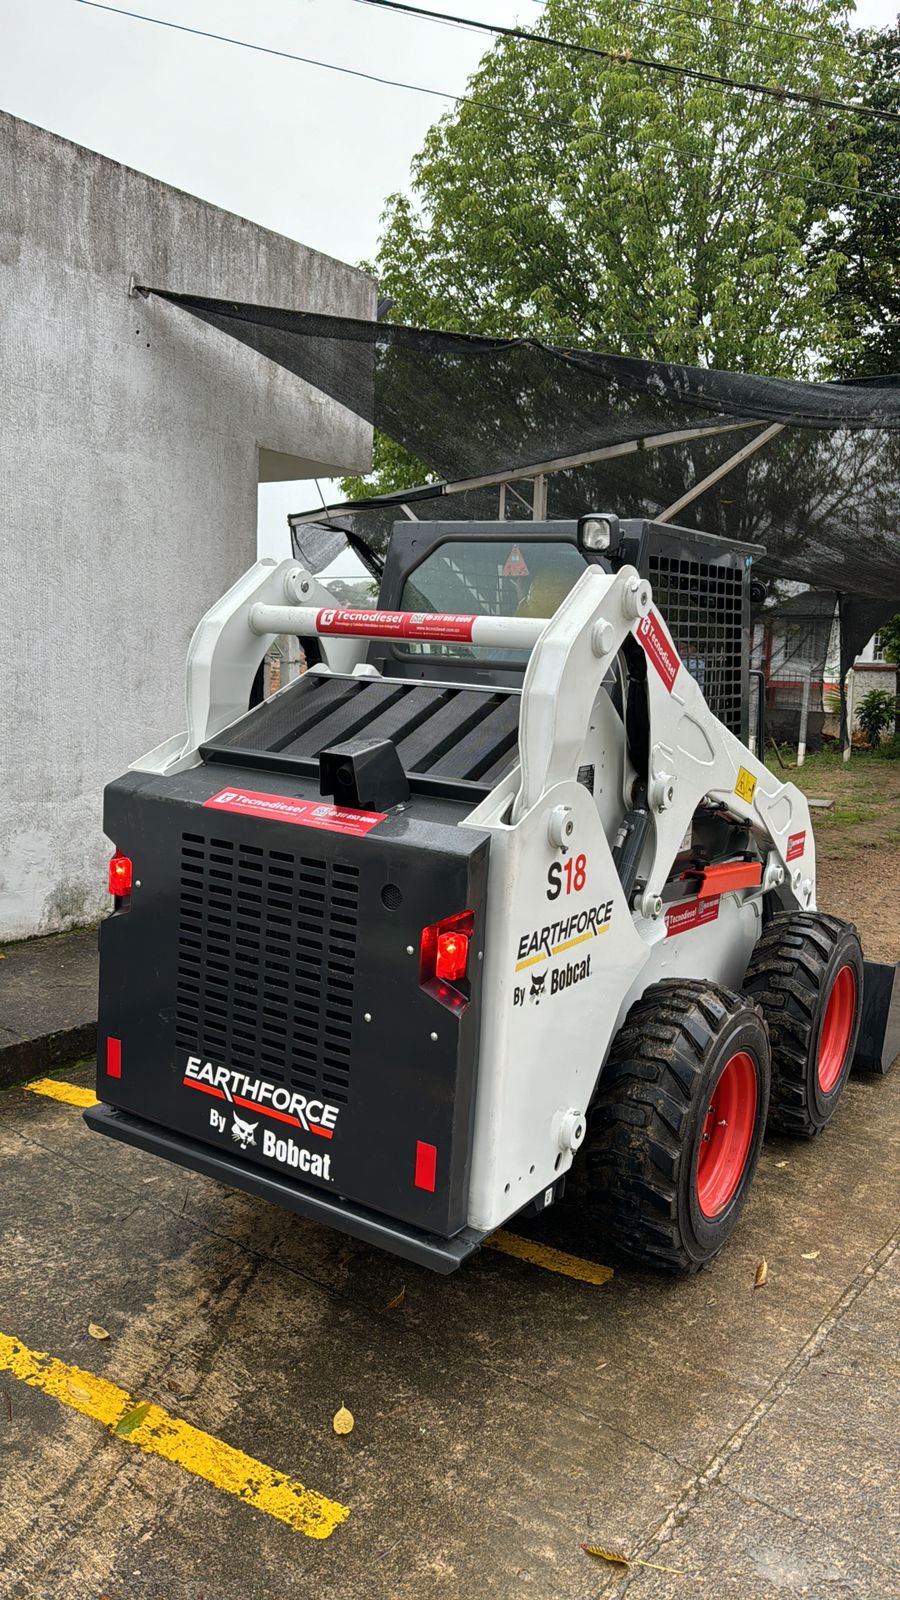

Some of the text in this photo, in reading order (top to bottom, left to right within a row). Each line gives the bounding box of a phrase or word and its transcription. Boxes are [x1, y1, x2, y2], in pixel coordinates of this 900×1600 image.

[337, 610, 404, 623] Tecnodiesel
[649, 626, 677, 678] Tecnodiesel
[235, 795, 307, 813] Tecnodiesel
[546, 853, 587, 901] S18
[517, 900, 614, 957] EARTHFORCE
[669, 907, 697, 925] Tecnodiesel
[513, 954, 592, 1007] By Bobcat
[184, 1056, 340, 1131] EARTHFORCE
[209, 1108, 332, 1181] By Bobcat
